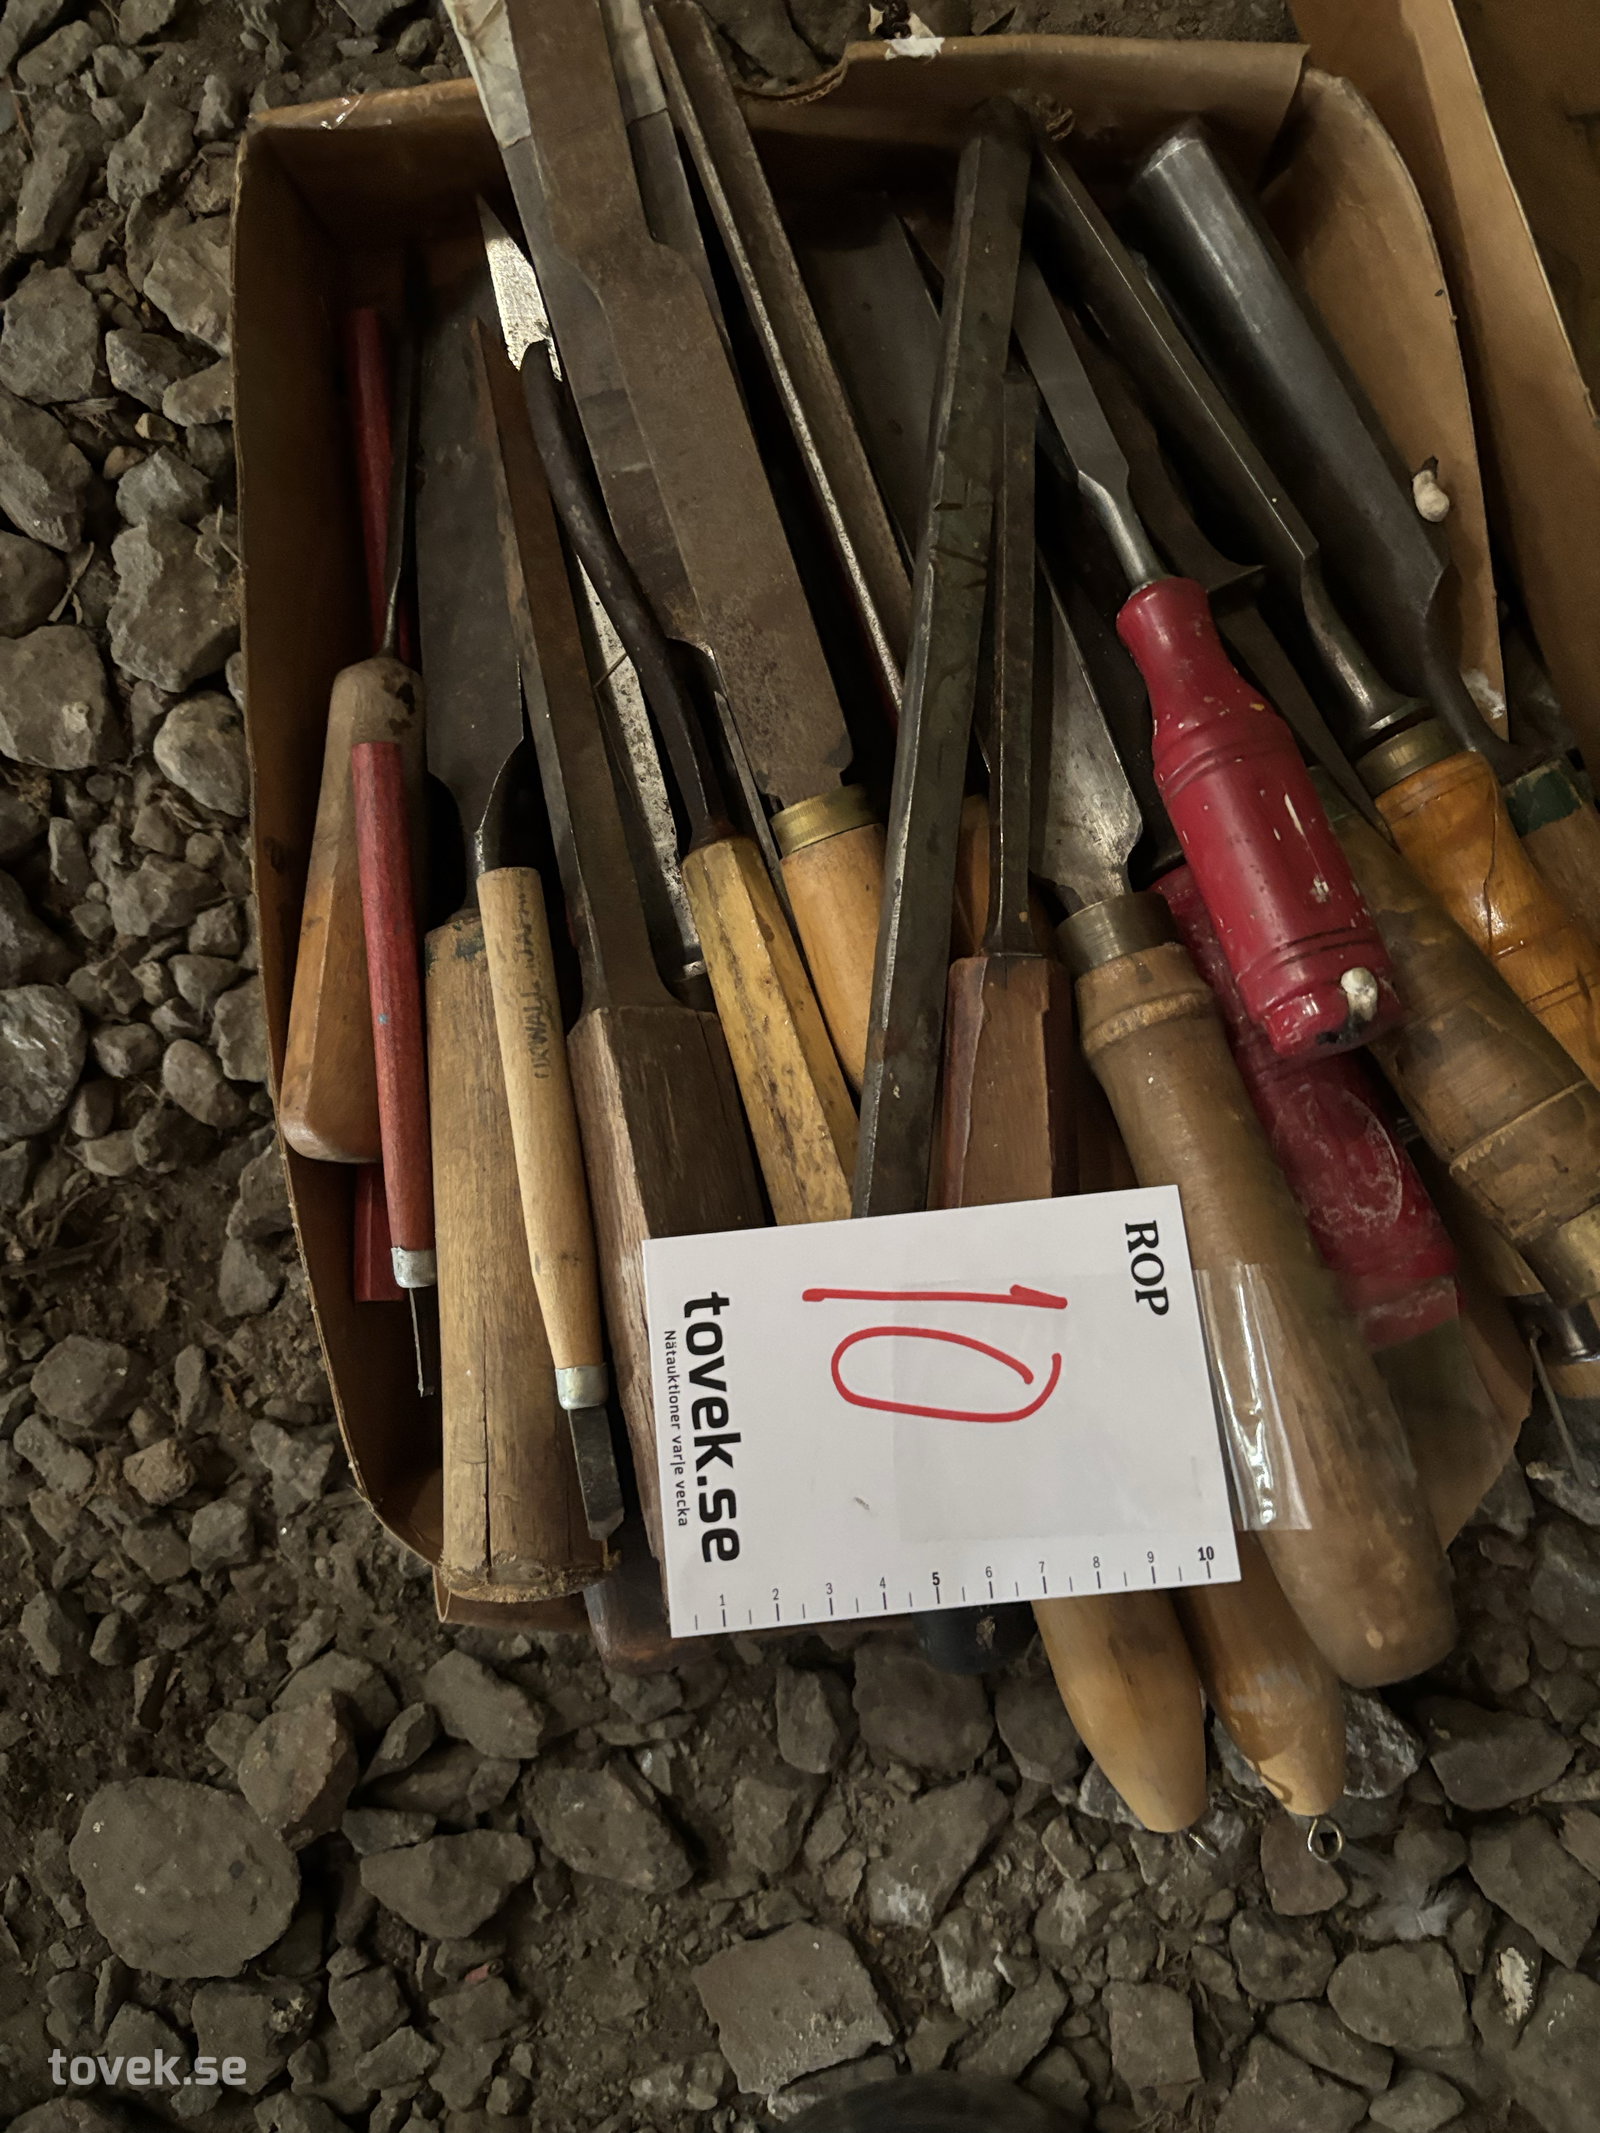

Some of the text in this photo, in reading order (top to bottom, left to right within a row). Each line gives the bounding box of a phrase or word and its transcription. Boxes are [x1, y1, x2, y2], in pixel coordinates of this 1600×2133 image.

[1125, 1220, 1169, 1316] ROP
[802, 1284, 1068, 1423] 10
[664, 1330, 691, 1527] Nätauktioner varje vecka
[684, 1291, 742, 1563] tovek.se
[719, 1545, 1215, 1606] 1 2 3 4 5 6 7 8 9 10
